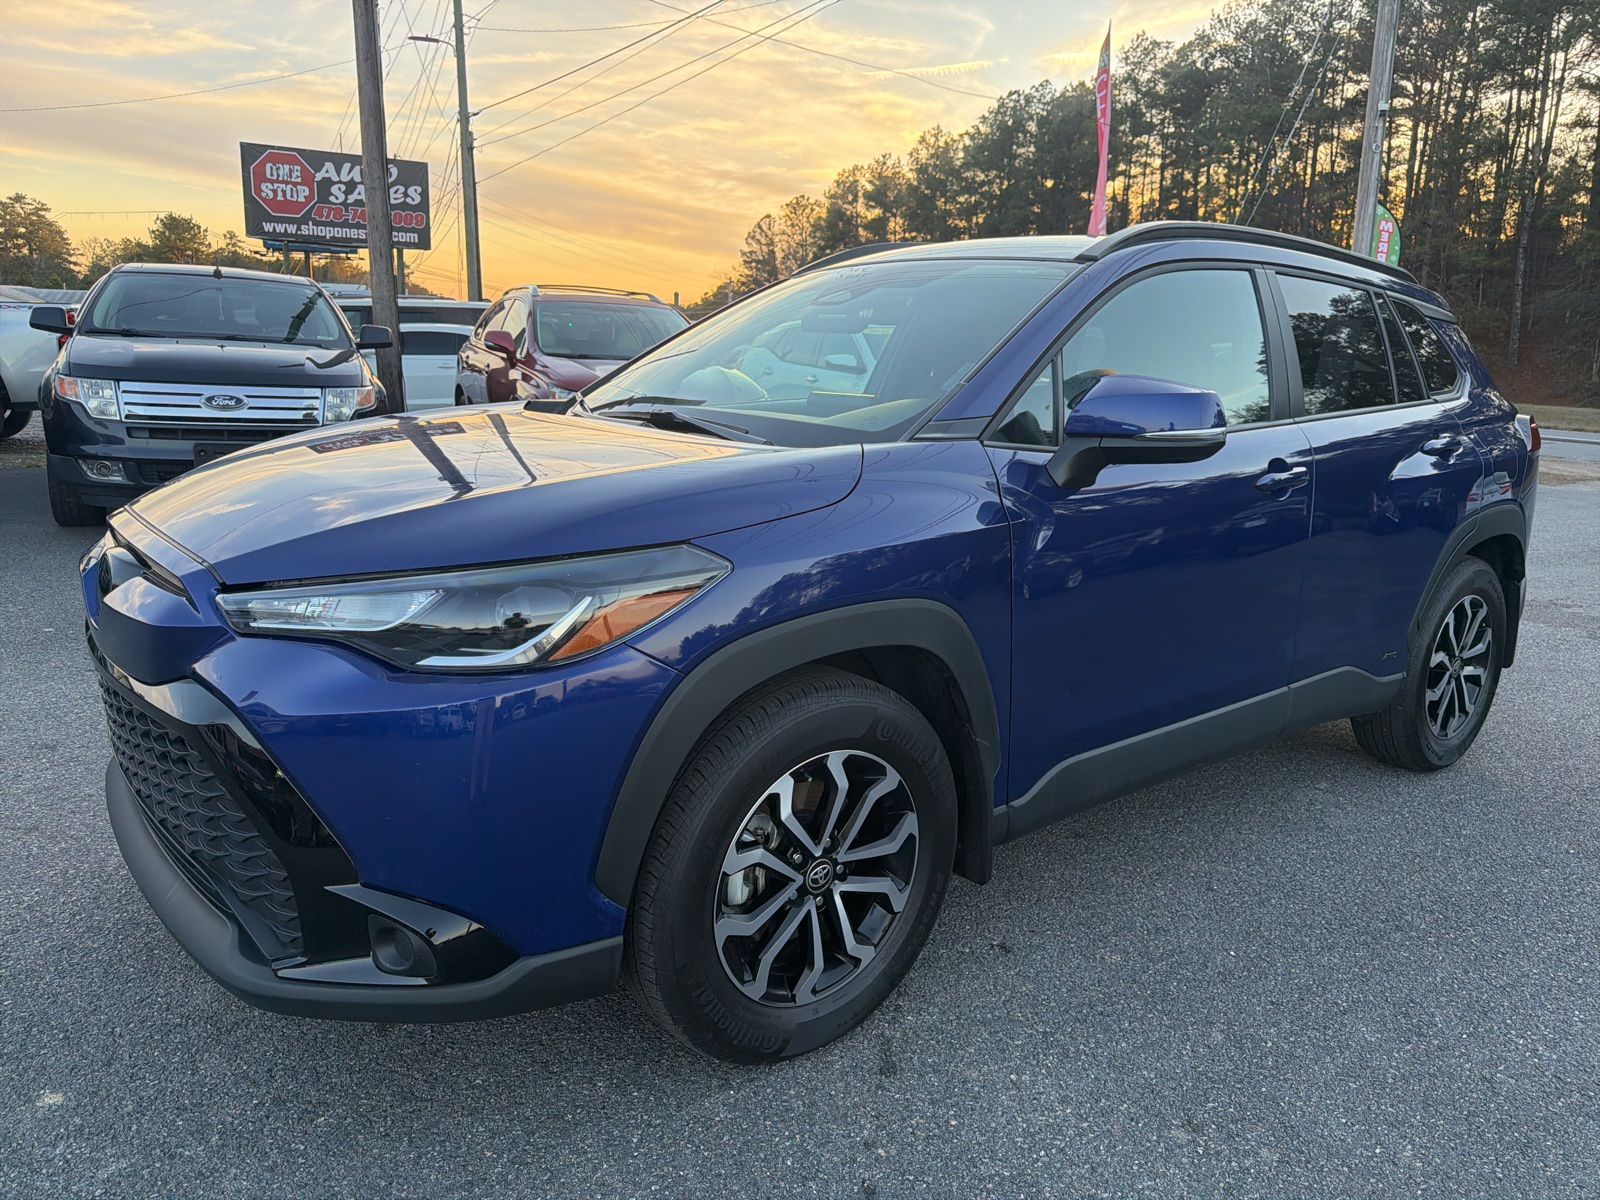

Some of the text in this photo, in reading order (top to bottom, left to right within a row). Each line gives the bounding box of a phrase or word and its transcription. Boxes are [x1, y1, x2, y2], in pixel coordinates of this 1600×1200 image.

[265, 162, 302, 182] ONE
[314, 161, 398, 183] AUO
[260, 182, 310, 203] STOP
[328, 183, 422, 205] SAES
